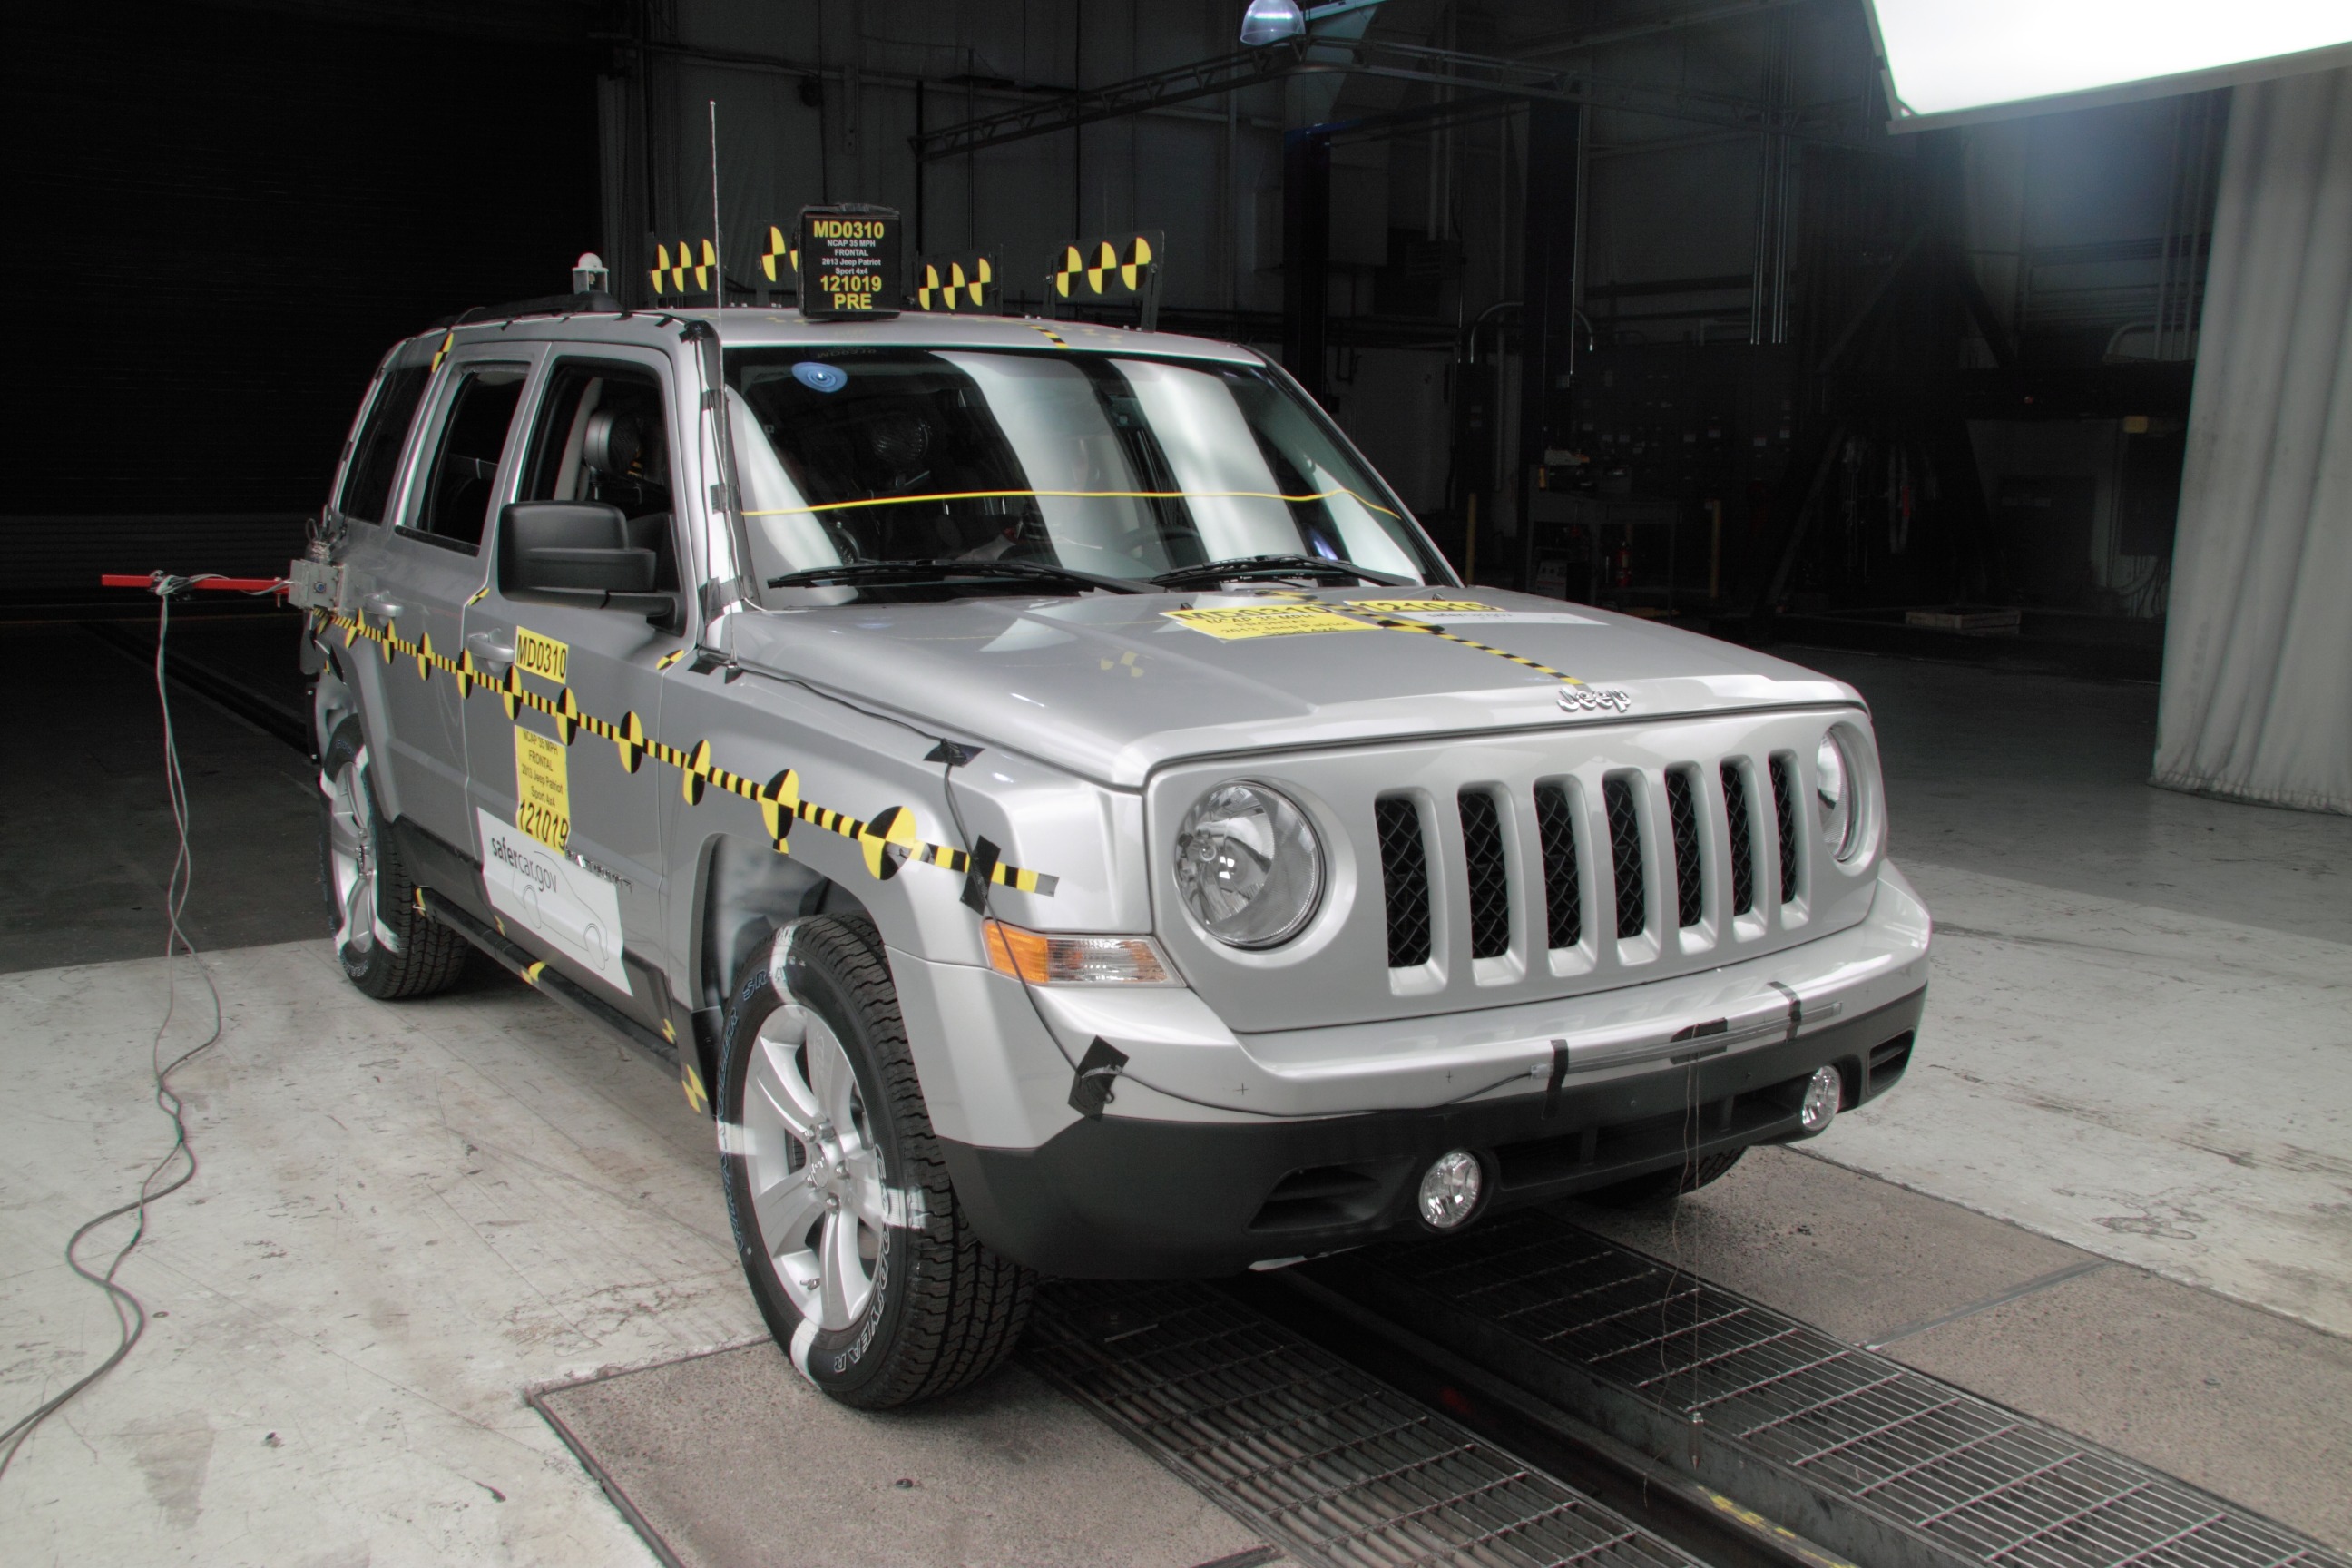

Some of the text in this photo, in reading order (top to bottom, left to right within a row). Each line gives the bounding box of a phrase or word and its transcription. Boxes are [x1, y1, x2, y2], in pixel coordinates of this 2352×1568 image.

[814, 220, 885, 239] MD0310
[834, 249, 868, 257] FRONTAL
[840, 259, 857, 267] Jeep
[858, 258, 881, 266] Patriot
[835, 268, 855, 276] Sport
[820, 275, 882, 292] 121019
[834, 293, 873, 309] PRE
[1172, 606, 1333, 620] MD0310
[516, 634, 567, 679] MD0310
[1556, 686, 1631, 713] Jeep
[522, 729, 538, 745] NCAP
[545, 740, 559, 755] MPH
[528, 749, 554, 772] FRONTAL
[522, 763, 564, 795] 2013 Jeep Patriot
[531, 785, 546, 803] Sport
[519, 799, 570, 851] 121019
[491, 836, 557, 894] safercar.gov
